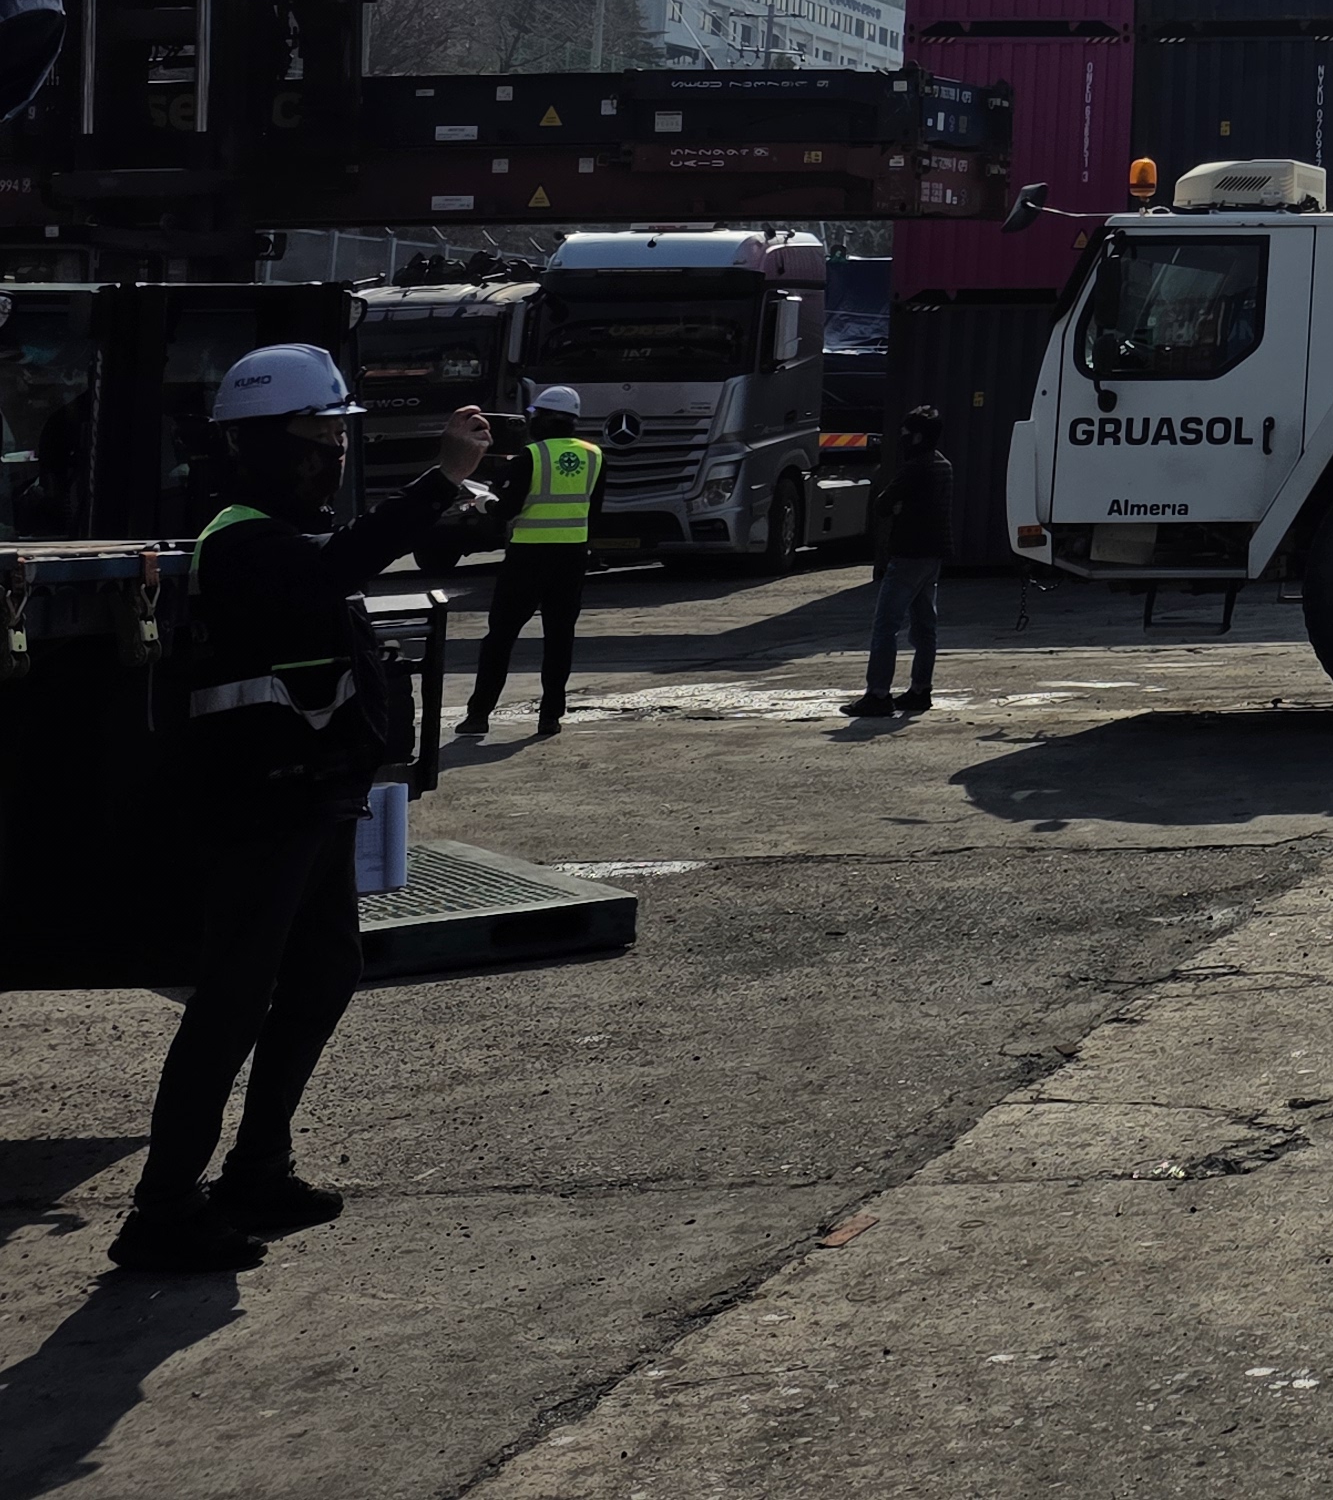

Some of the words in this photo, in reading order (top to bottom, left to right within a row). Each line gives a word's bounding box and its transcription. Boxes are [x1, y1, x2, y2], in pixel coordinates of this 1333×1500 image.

[669, 159, 725, 168] CAIU
[233, 374, 272, 389] KUMO
[1068, 416, 1254, 446] GRUASOL
